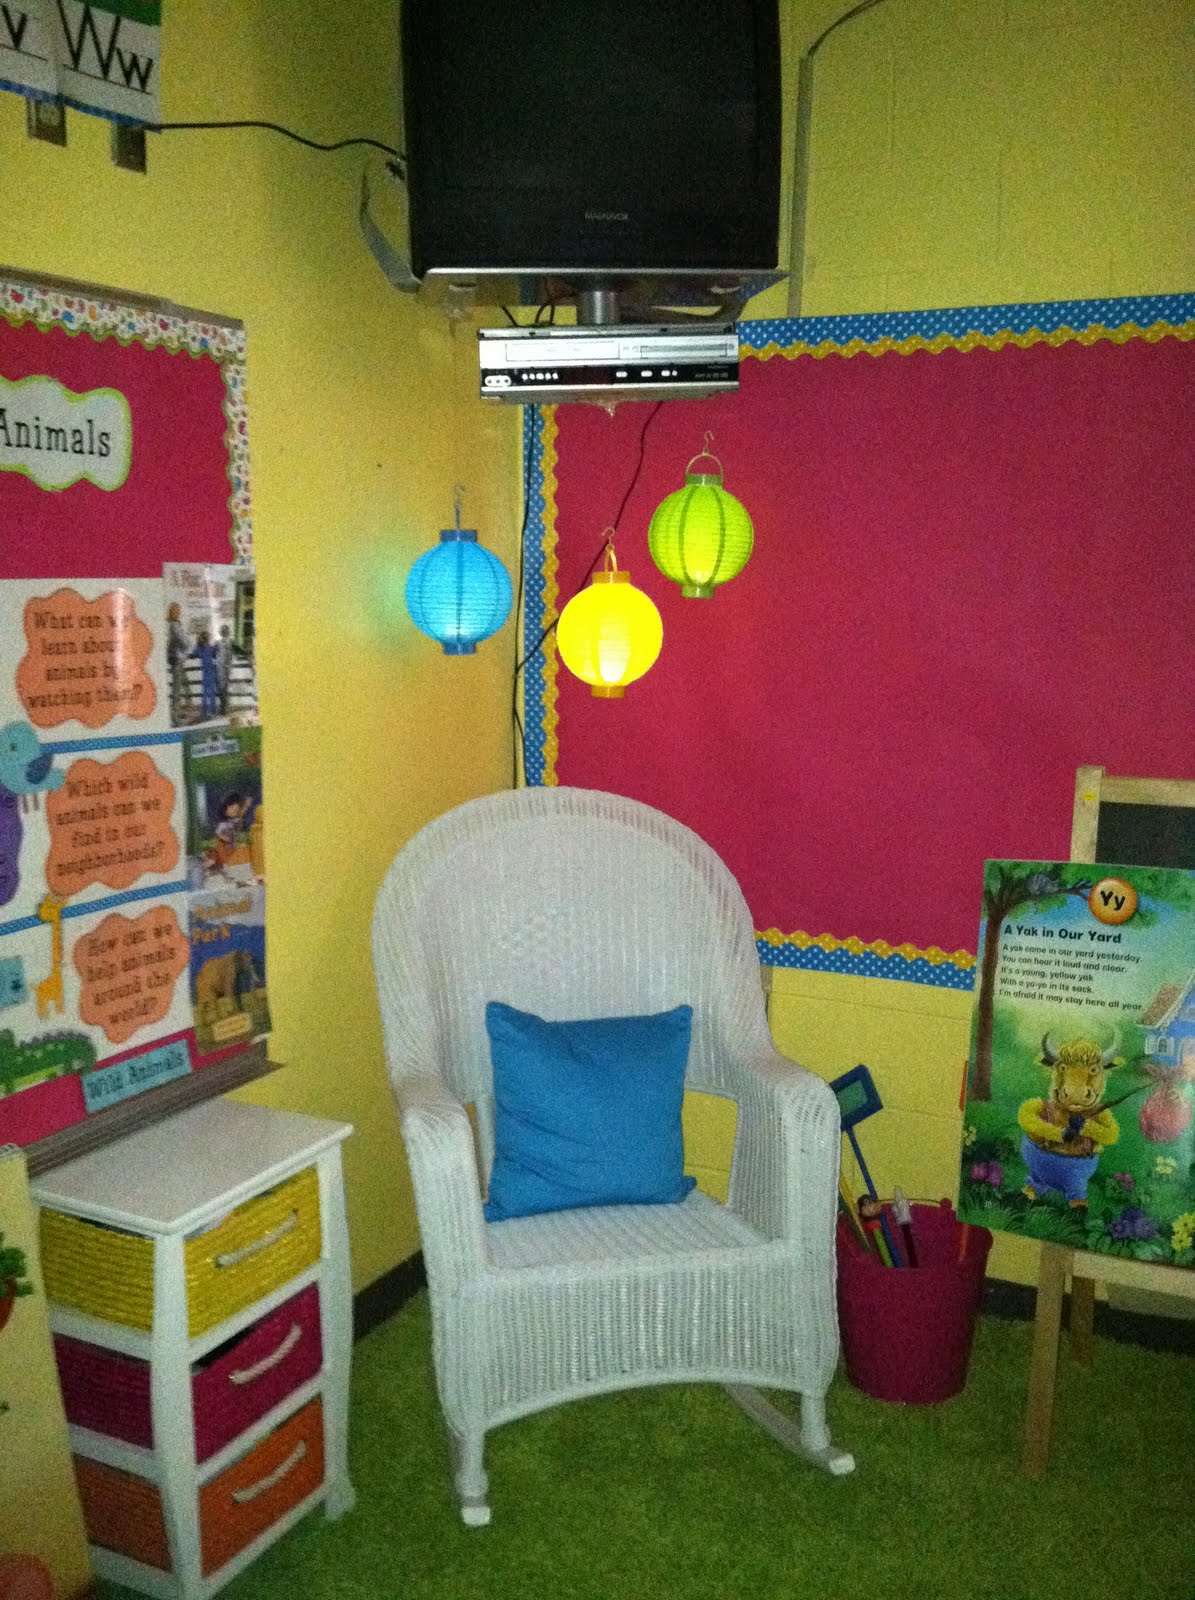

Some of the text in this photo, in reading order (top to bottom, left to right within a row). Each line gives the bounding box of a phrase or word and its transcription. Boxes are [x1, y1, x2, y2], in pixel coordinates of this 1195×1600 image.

[79, 615, 103, 628] can
[41, 638, 78, 655] learn
[46, 661, 98, 681] animals
[27, 687, 93, 708] watching
[56, 803, 108, 826] animals
[113, 802, 136, 816] can
[1100, 890, 1126, 911] Yy
[1004, 925, 1122, 943] A Yak in Our Yard
[1025, 946, 1046, 954] came
[1075, 949, 1094, 958] yard
[1003, 955, 1016, 963] You
[1034, 957, 1051, 966] hear
[1063, 959, 1081, 969] loud
[1083, 961, 1100, 970] and
[1000, 977, 1017, 985] With
[1059, 982, 1069, 991] its
[1050, 970, 1076, 980] yellow
[1079, 972, 1094, 982] yak
[1014, 991, 1036, 999] afraid
[1046, 994, 1063, 1003] may
[1065, 996, 1083, 1005] stay
[1085, 997, 1106, 1007] here
[1108, 1000, 1119, 1008] all
